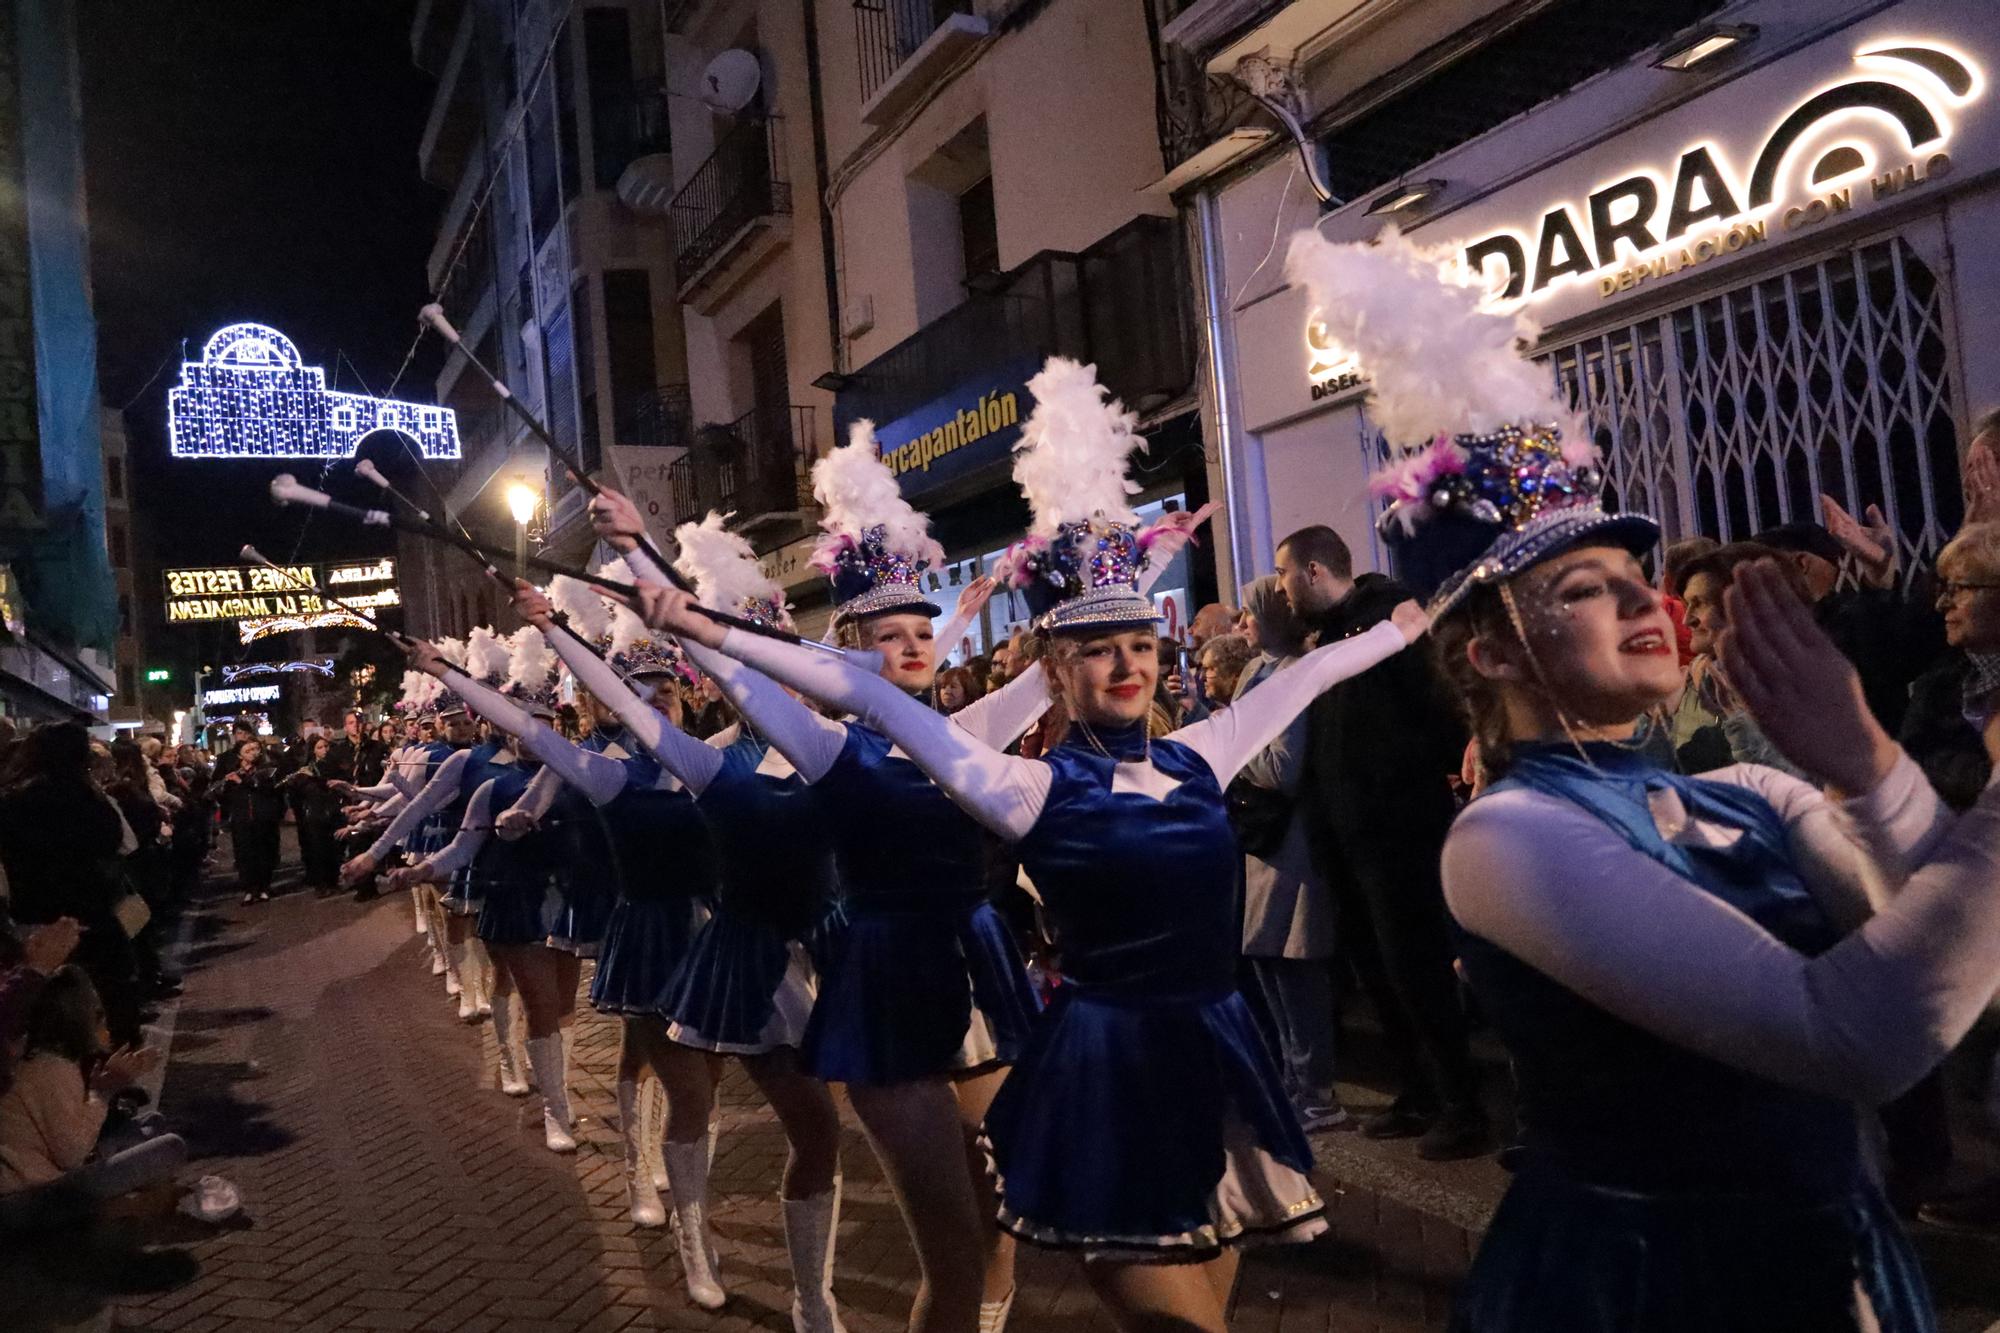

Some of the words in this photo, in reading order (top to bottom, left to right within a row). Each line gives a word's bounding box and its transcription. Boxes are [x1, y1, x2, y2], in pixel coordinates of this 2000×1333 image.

[1466, 147, 1741, 298] DARA
[1599, 220, 1768, 297] DEPILACIÓN
[1782, 188, 1851, 232] CON
[1870, 153, 1951, 201] HILO
[877, 390, 1018, 476] ercapantalón
[763, 554, 796, 579] osset
